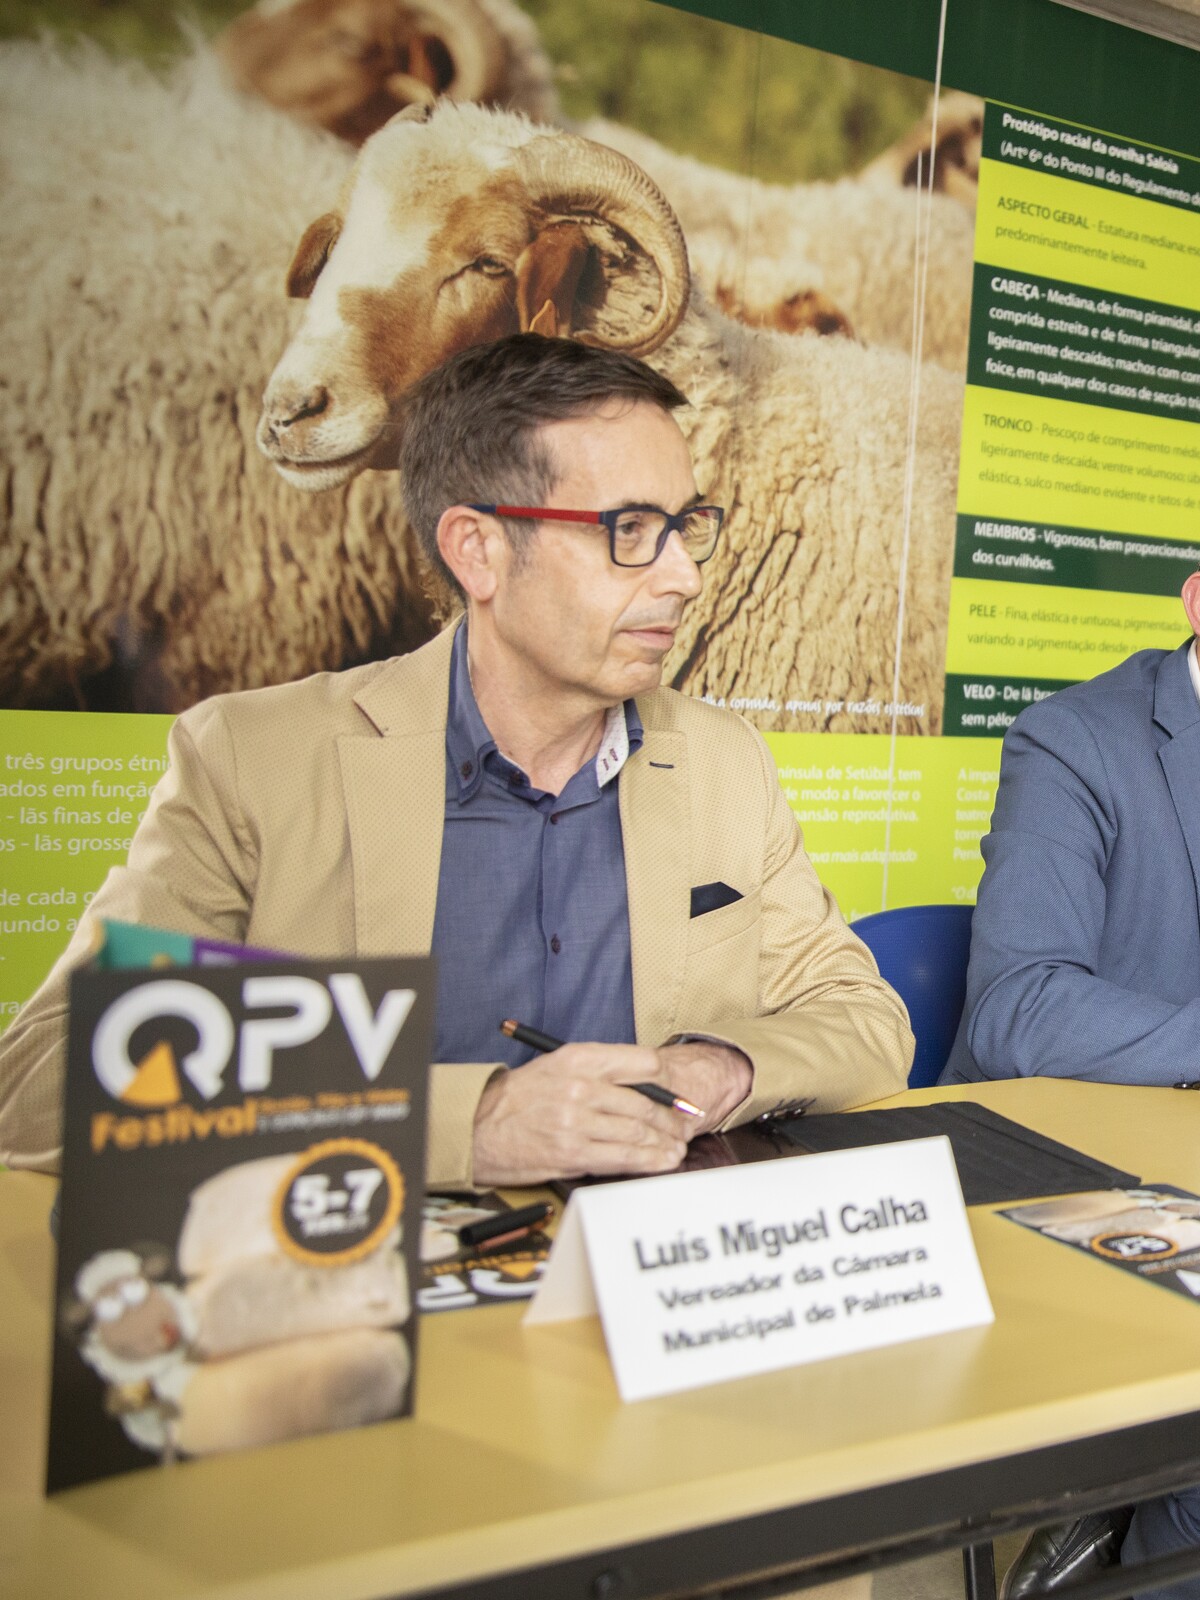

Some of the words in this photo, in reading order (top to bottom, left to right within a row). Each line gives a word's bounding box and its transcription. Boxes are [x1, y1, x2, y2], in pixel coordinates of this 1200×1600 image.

[1003, 113, 1058, 141] Protótipo
[1060, 130, 1092, 150] racial
[1092, 138, 1107, 153] da
[1108, 144, 1145, 165] ovelha
[1146, 153, 1179, 174] Saloia
[1043, 152, 1059, 168] do
[1060, 157, 1094, 178] Ponto
[1105, 168, 1121, 185] do
[1122, 174, 1190, 204] Regulamento
[997, 196, 1050, 220] ASPECTO
[1053, 210, 1089, 228] GERAL
[1098, 220, 1139, 243] Estatura
[995, 226, 1108, 260] predominantemente
[1111, 247, 1148, 270] leiteira.
[991, 277, 1039, 301] CABEÇA
[1096, 300, 1111, 315] de
[1112, 303, 1143, 321] forma
[989, 306, 1045, 329] comprida
[1047, 317, 1089, 337] estreita
[1101, 326, 1115, 342] de
[1117, 329, 1149, 348] forma
[987, 331, 1058, 358] ligeiramente
[1116, 357, 1156, 376] machos
[1157, 366, 1180, 380] com
[986, 357, 1016, 377] foice,
[1016, 366, 1036, 380] em
[1037, 368, 1086, 392] qualquer
[1087, 377, 1107, 392] dos
[1108, 383, 1136, 398] casos
[1138, 386, 1152, 401] de
[982, 413, 1032, 434] TRONCO
[1042, 422, 1085, 447] Pescoço
[1087, 431, 1101, 446] de
[1102, 435, 1171, 456] comprimento
[1054, 478, 1101, 497] mediano
[1103, 485, 1147, 503] evidente
[974, 521, 1036, 543] MEMBROS
[1043, 529, 1097, 551] Vigorosos,
[1099, 535, 1123, 551] bem
[972, 549, 993, 565] dos
[995, 549, 1055, 571] curvilhões.
[969, 604, 997, 618] PELE
[1031, 608, 1069, 625] elástica
[967, 631, 1016, 647] variando
[1027, 635, 1096, 655] pigmentação
[1098, 639, 1129, 655] desde
[963, 684, 995, 700] VELO
[1003, 685, 1020, 701] De
[961, 713, 985, 727] sem
[6, 753, 45, 770] três
[50, 756, 124, 775] grupos
[825, 765, 842, 780] de
[898, 768, 922, 781] tem
[53, 784, 86, 797] em
[801, 786, 840, 801] modo
[20, 807, 48, 824] lãs
[53, 806, 101, 824] finas
[107, 807, 133, 824] de
[27, 887, 77, 905] cada
[91, 972, 418, 1104] QPV
[91, 1105, 259, 1152] Festival
[290, 1167, 385, 1221] 5-7
[719, 1207, 830, 1258] Miguel
[839, 1197, 929, 1235] Calha
[658, 1273, 783, 1310] Vereador
[793, 1265, 825, 1286] da
[662, 1307, 796, 1353] Municipal
[805, 1301, 836, 1324] de
[844, 1280, 943, 1317] Palmela
